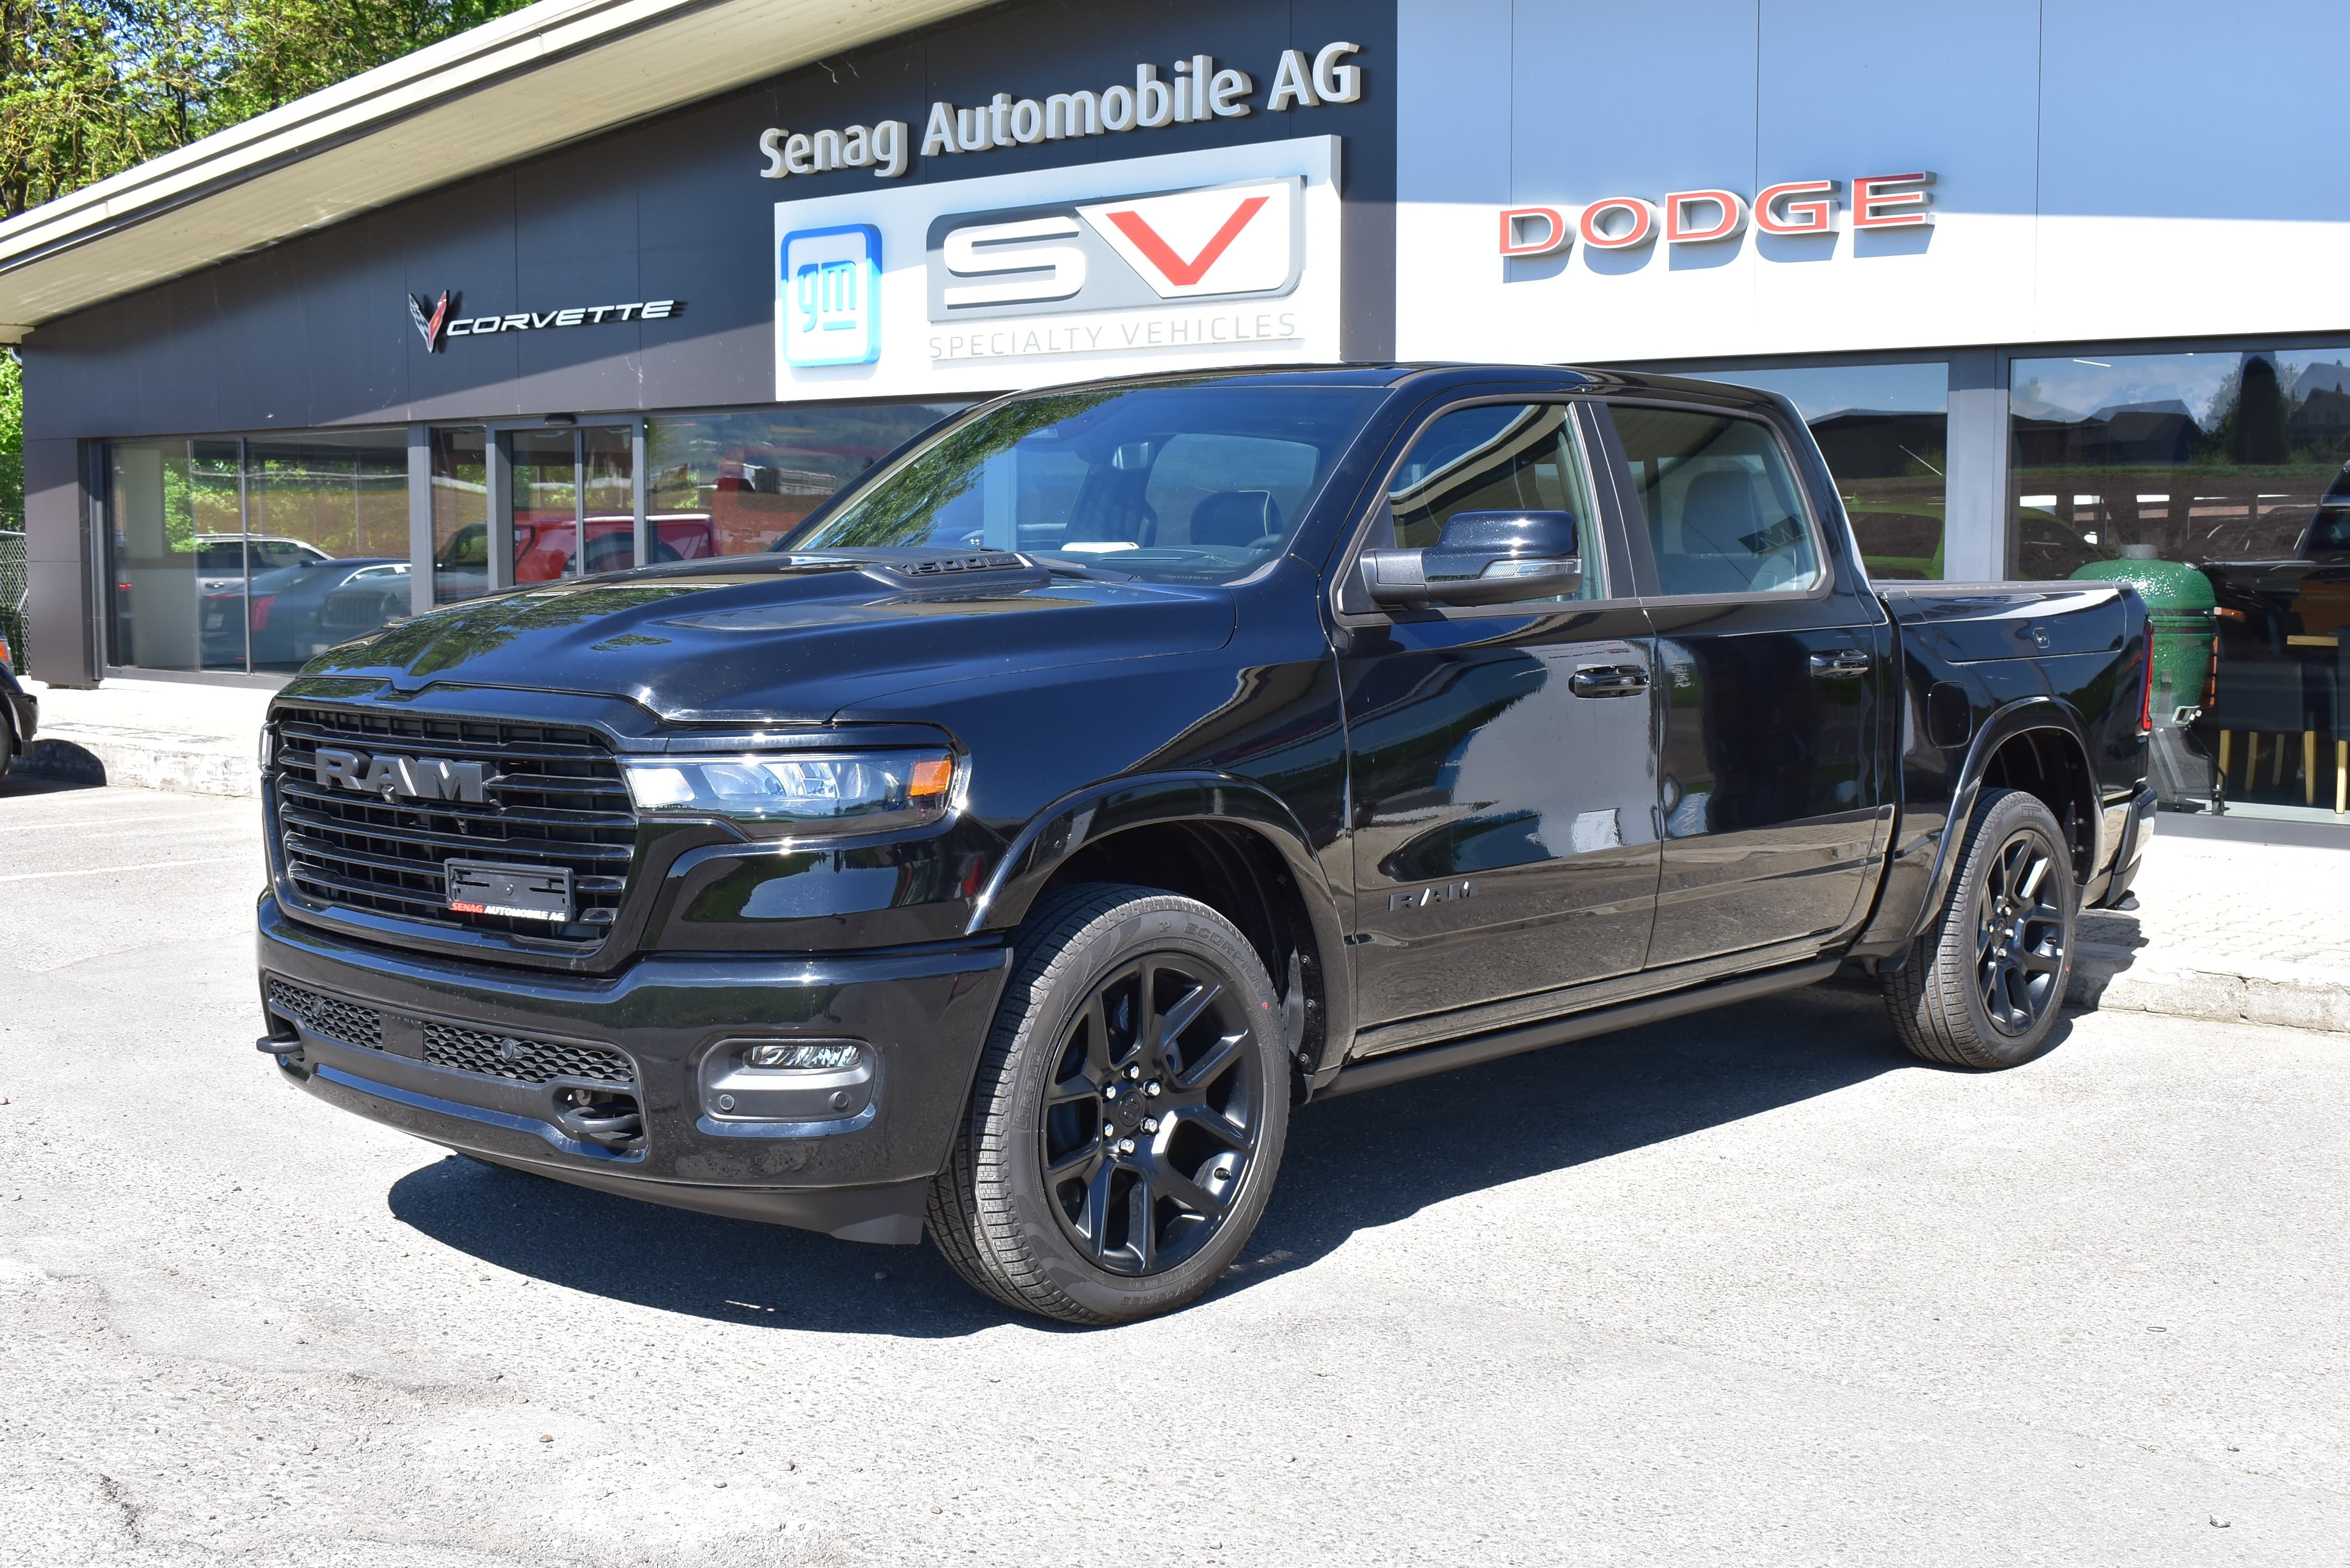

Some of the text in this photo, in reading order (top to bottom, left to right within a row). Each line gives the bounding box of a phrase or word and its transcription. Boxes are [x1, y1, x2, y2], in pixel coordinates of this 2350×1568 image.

[759, 41, 1361, 178] Senag Automobile AG
[1500, 171, 1936, 258] DODGE
[943, 195, 1271, 308] SV
[446, 299, 675, 337] CORVETTE
[796, 259, 857, 333] gm
[929, 312, 1296, 360] SPECIALTY VEHICLES
[315, 746, 487, 803] RAM
[452, 902, 566, 921] SENAG AUTOMOBILE AG
[1389, 879, 1479, 912] RAM
[1183, 922, 1268, 997] SCORPION
